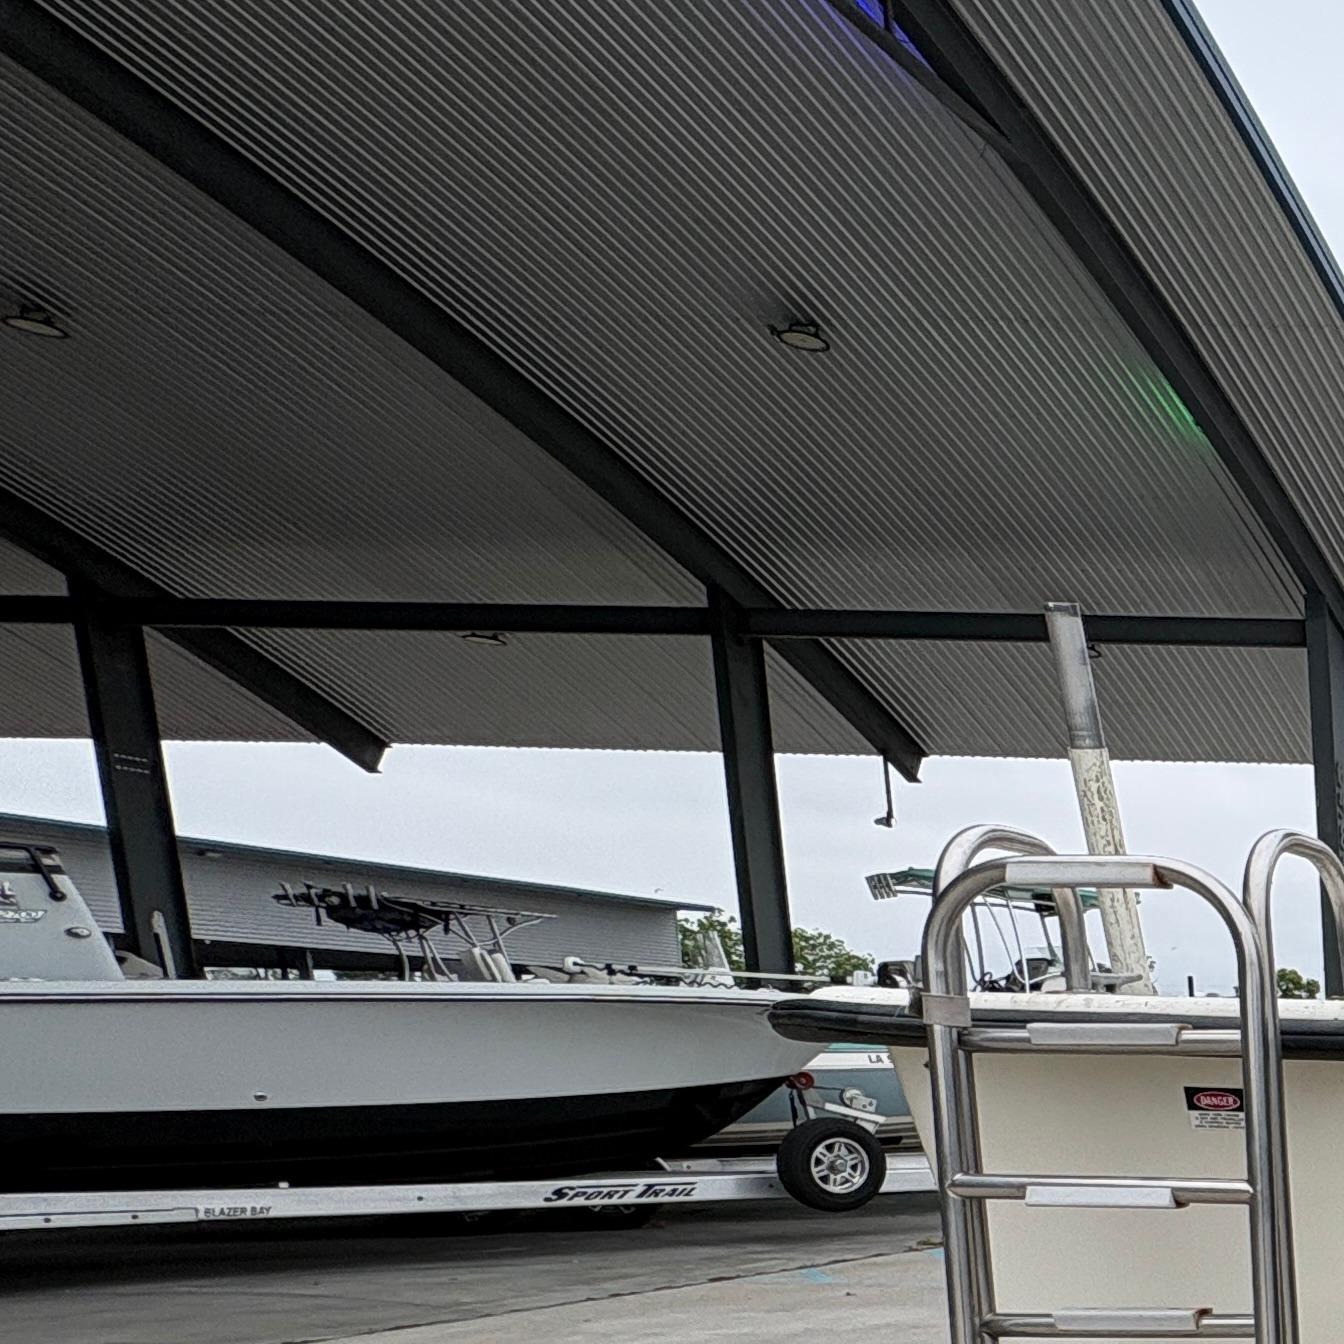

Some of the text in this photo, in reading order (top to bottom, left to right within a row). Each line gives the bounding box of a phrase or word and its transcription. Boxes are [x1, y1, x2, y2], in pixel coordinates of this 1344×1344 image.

[868, 1055, 884, 1064] LA
[1200, 1095, 1234, 1106] DANGER
[250, 1206, 272, 1216] BAY
